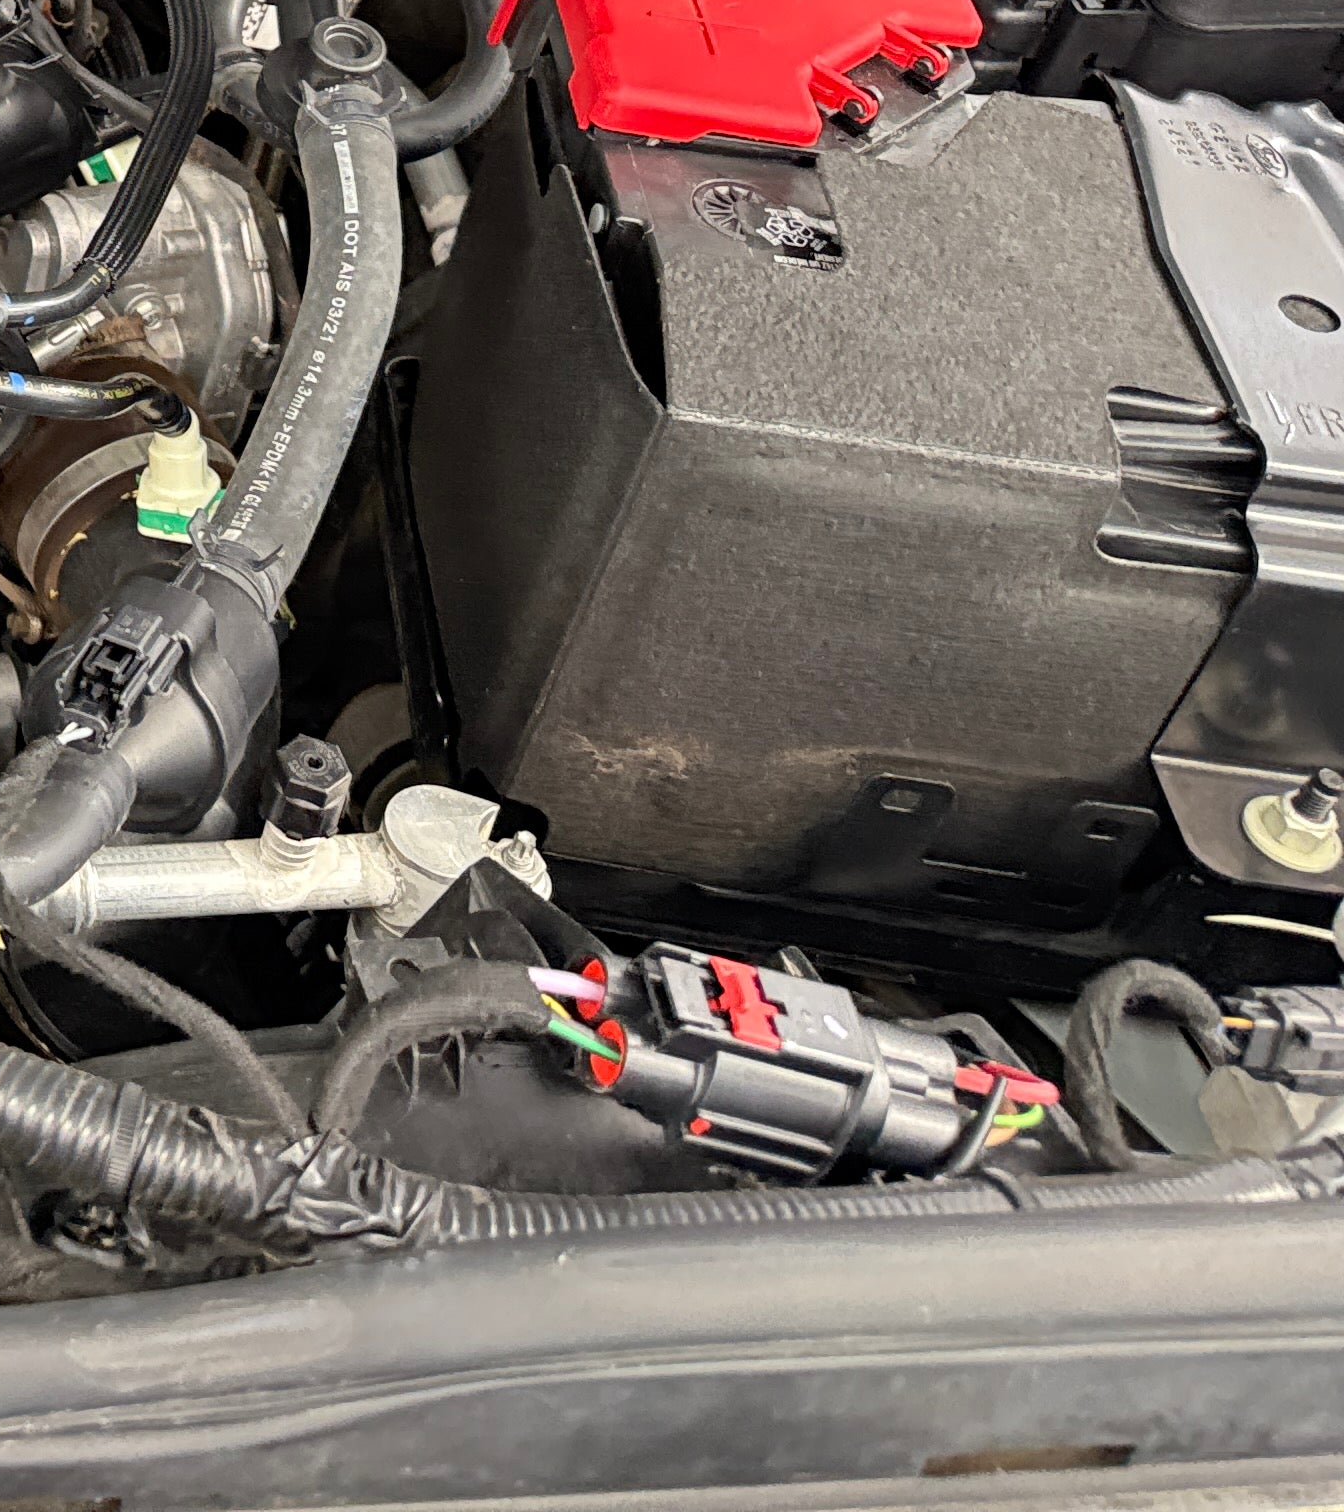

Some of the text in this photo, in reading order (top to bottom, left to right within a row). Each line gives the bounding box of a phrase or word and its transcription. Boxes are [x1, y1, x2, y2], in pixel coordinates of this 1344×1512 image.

[342, 220, 360, 259] DOT
[336, 262, 356, 293] AIS
[319, 296, 347, 343] 03/21
